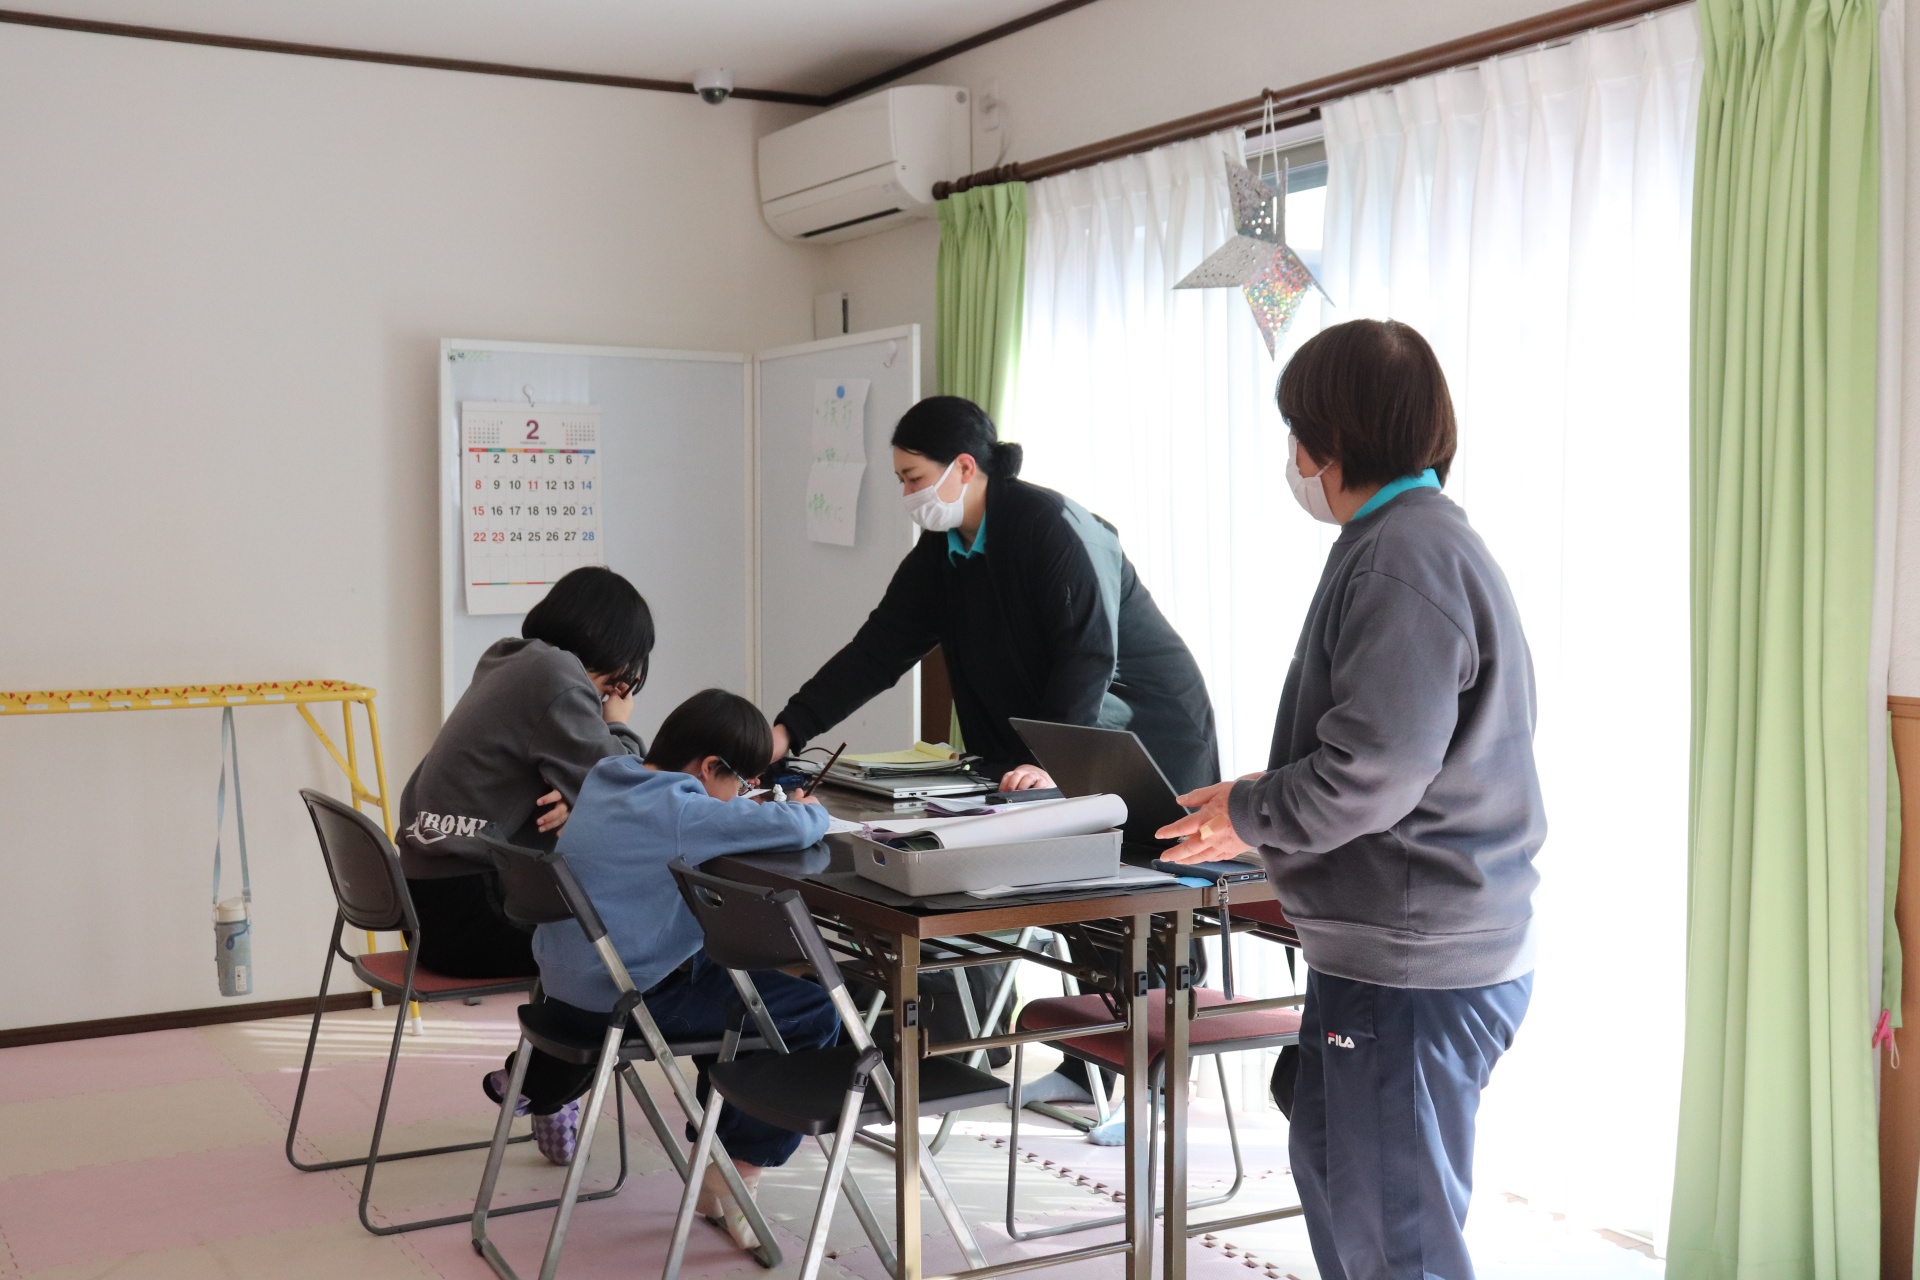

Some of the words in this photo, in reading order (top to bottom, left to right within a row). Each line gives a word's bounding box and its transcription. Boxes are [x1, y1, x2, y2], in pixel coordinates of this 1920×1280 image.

[526, 419, 539, 439] 2
[476, 454, 481, 464] 1
[493, 454, 500, 464] 2
[512, 454, 518, 464] 3
[530, 454, 537, 464] 4
[548, 454, 555, 464] 5
[566, 454, 573, 464] 6
[584, 454, 590, 464] 7
[475, 480, 482, 490] 8
[493, 480, 500, 490] 9
[509, 480, 521, 490] 10
[528, 480, 539, 490] 11
[545, 480, 557, 490] 12
[563, 480, 575, 490] 13
[581, 480, 592, 490] 14
[472, 506, 485, 516] 15
[491, 506, 503, 516] 16
[509, 506, 521, 516] 17
[527, 506, 539, 516] 18
[545, 506, 557, 516] 19
[563, 506, 576, 516] 20
[581, 506, 593, 516] 21
[473, 532, 487, 542] 22
[491, 532, 505, 542] 23
[510, 532, 522, 542] 24
[528, 532, 541, 542] 25
[546, 532, 559, 542] 26
[564, 532, 576, 542] 27
[582, 532, 595, 542] 28
[1328, 1031, 1355, 1049] FILA
